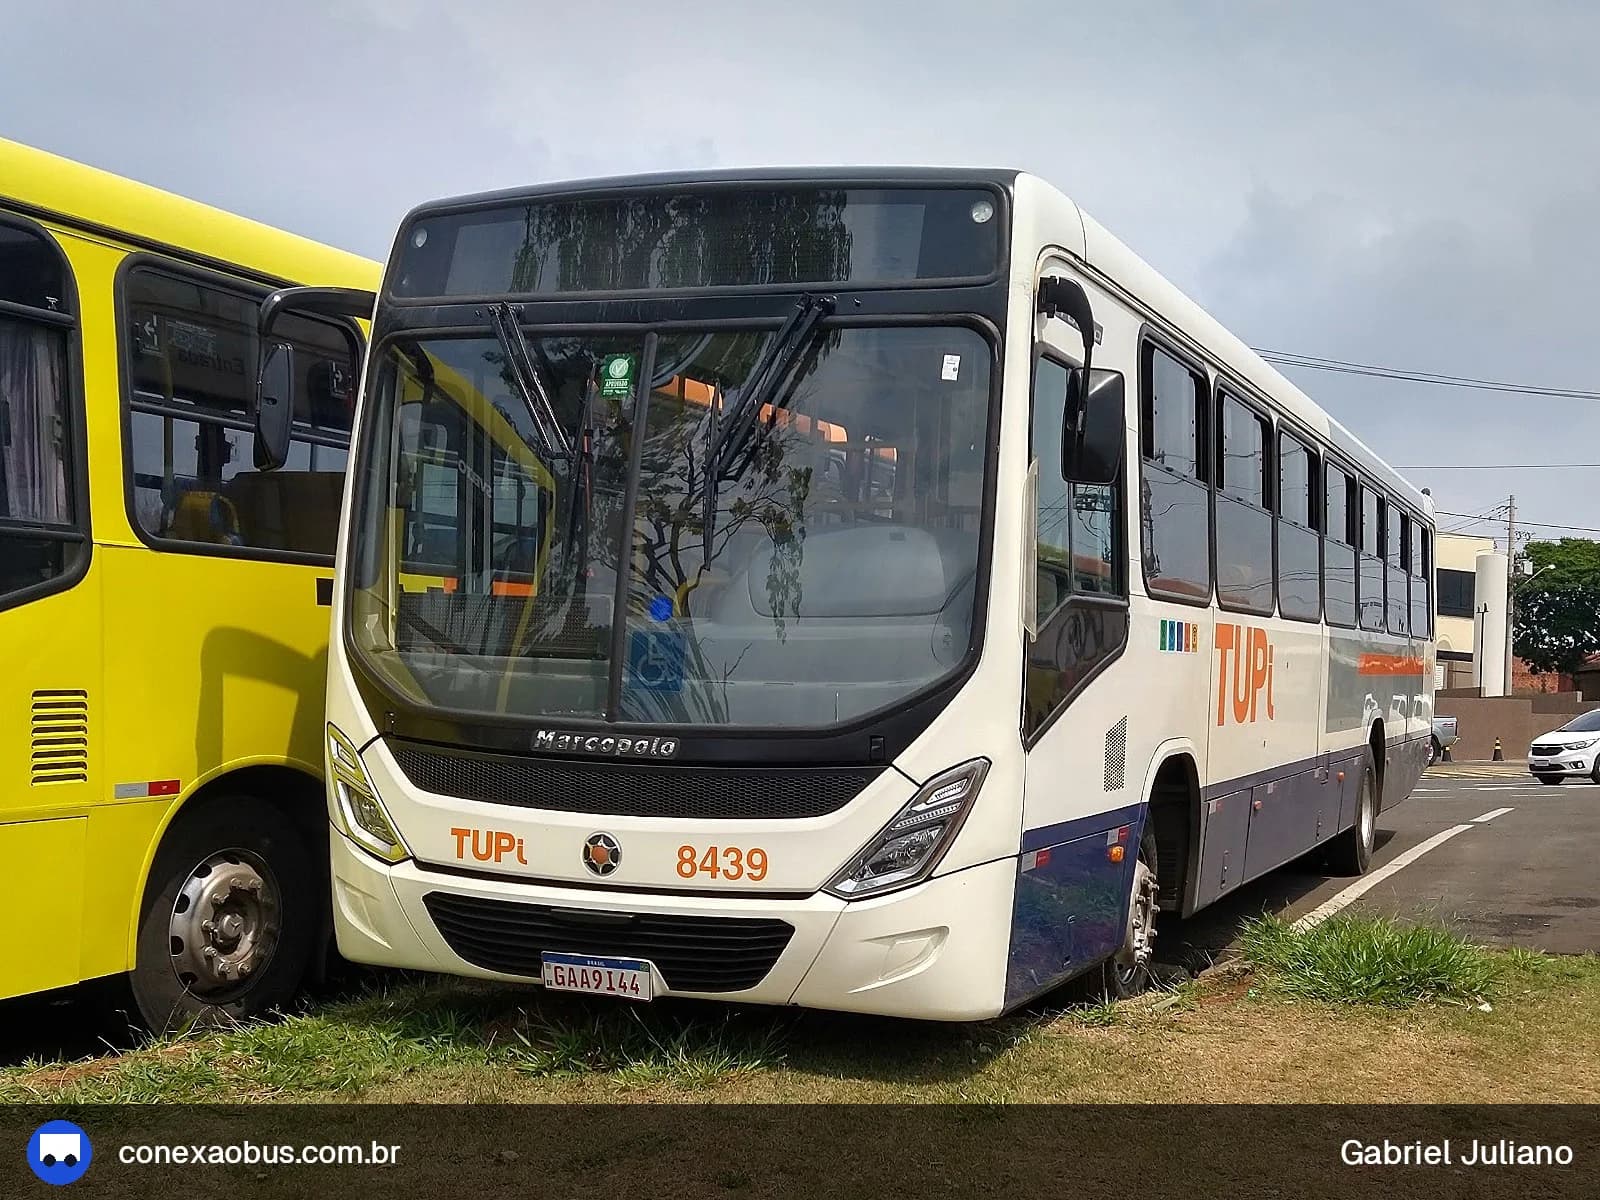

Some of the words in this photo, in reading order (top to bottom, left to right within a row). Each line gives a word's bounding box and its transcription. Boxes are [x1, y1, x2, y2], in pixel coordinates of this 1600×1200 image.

[535, 730, 676, 757] Marcopolo
[676, 846, 768, 882] 8439
[554, 966, 640, 995] GAA9I44
